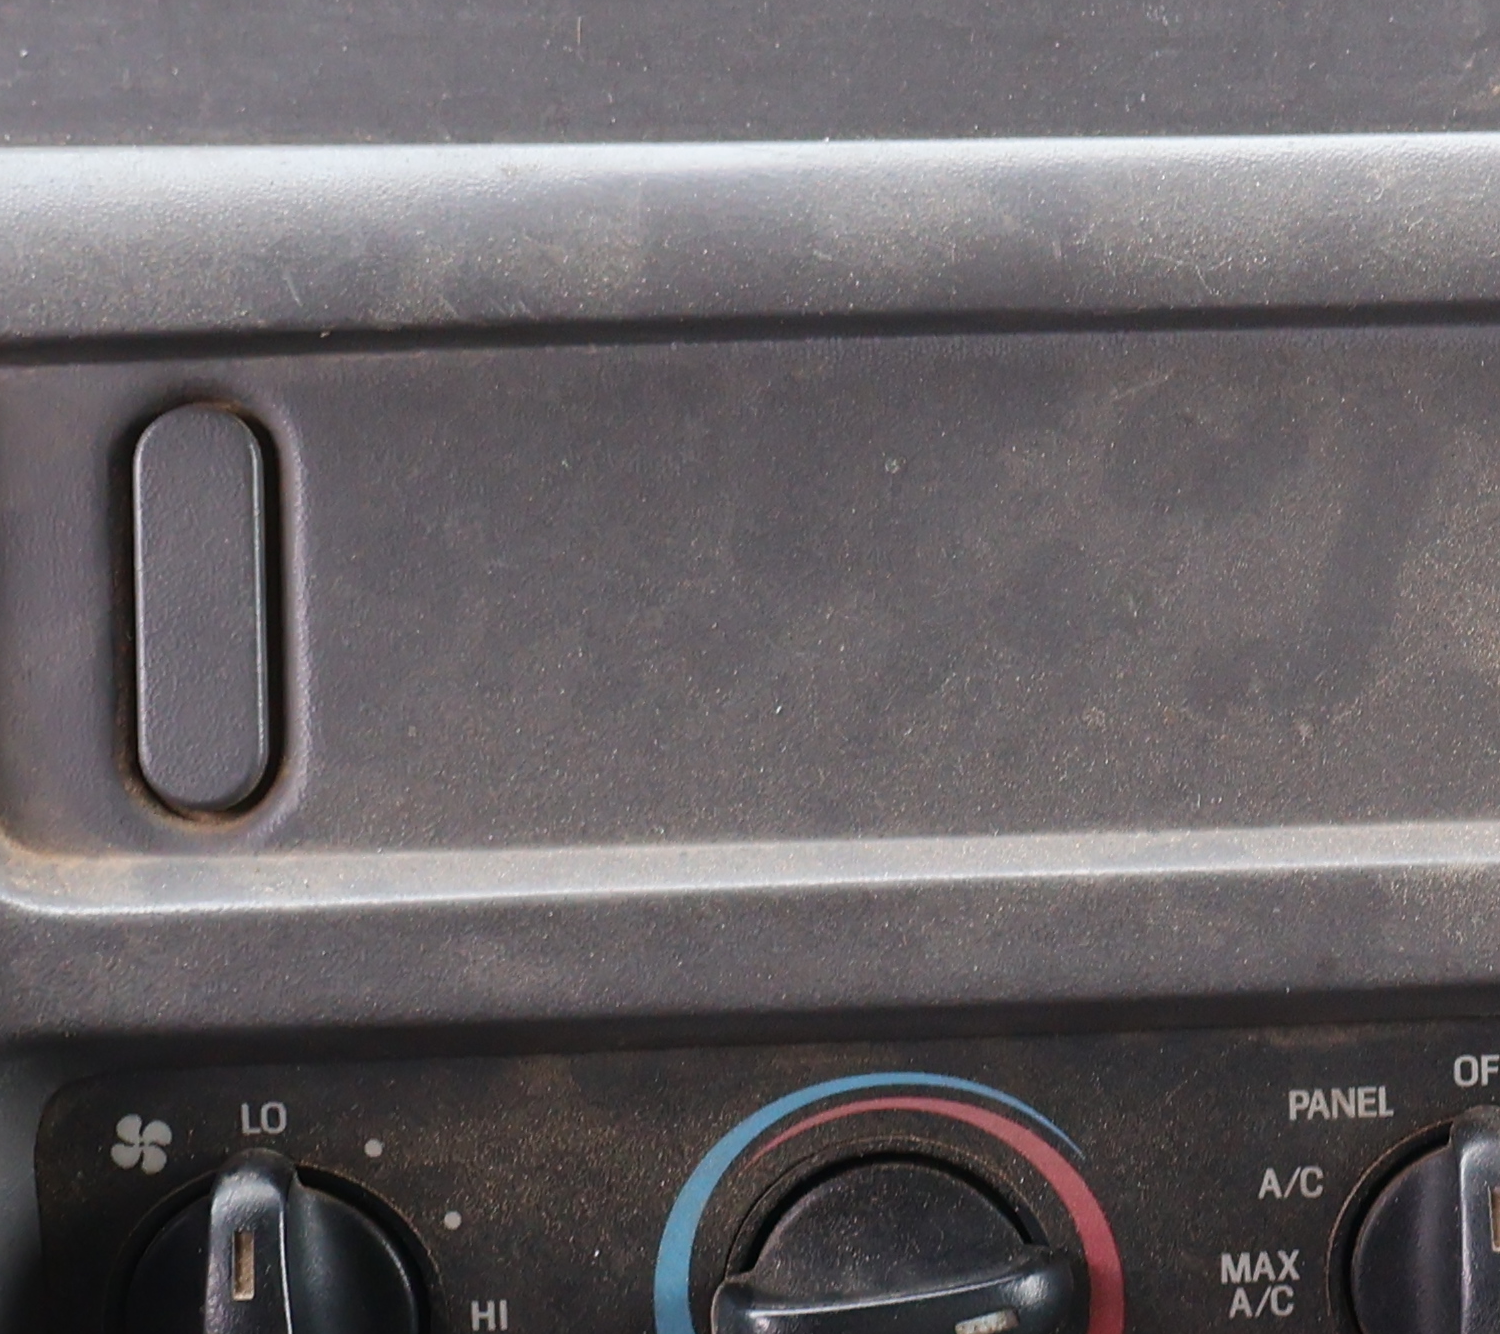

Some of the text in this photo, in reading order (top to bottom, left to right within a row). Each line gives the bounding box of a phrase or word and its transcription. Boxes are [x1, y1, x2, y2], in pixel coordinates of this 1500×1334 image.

[240, 1101, 288, 1135] LO
[1288, 1086, 1394, 1121] PANEL
[1257, 1166, 1325, 1200] A/C
[1221, 1248, 1300, 1284] MAX
[470, 1299, 509, 1332] HI
[1228, 1285, 1294, 1319] A/C
